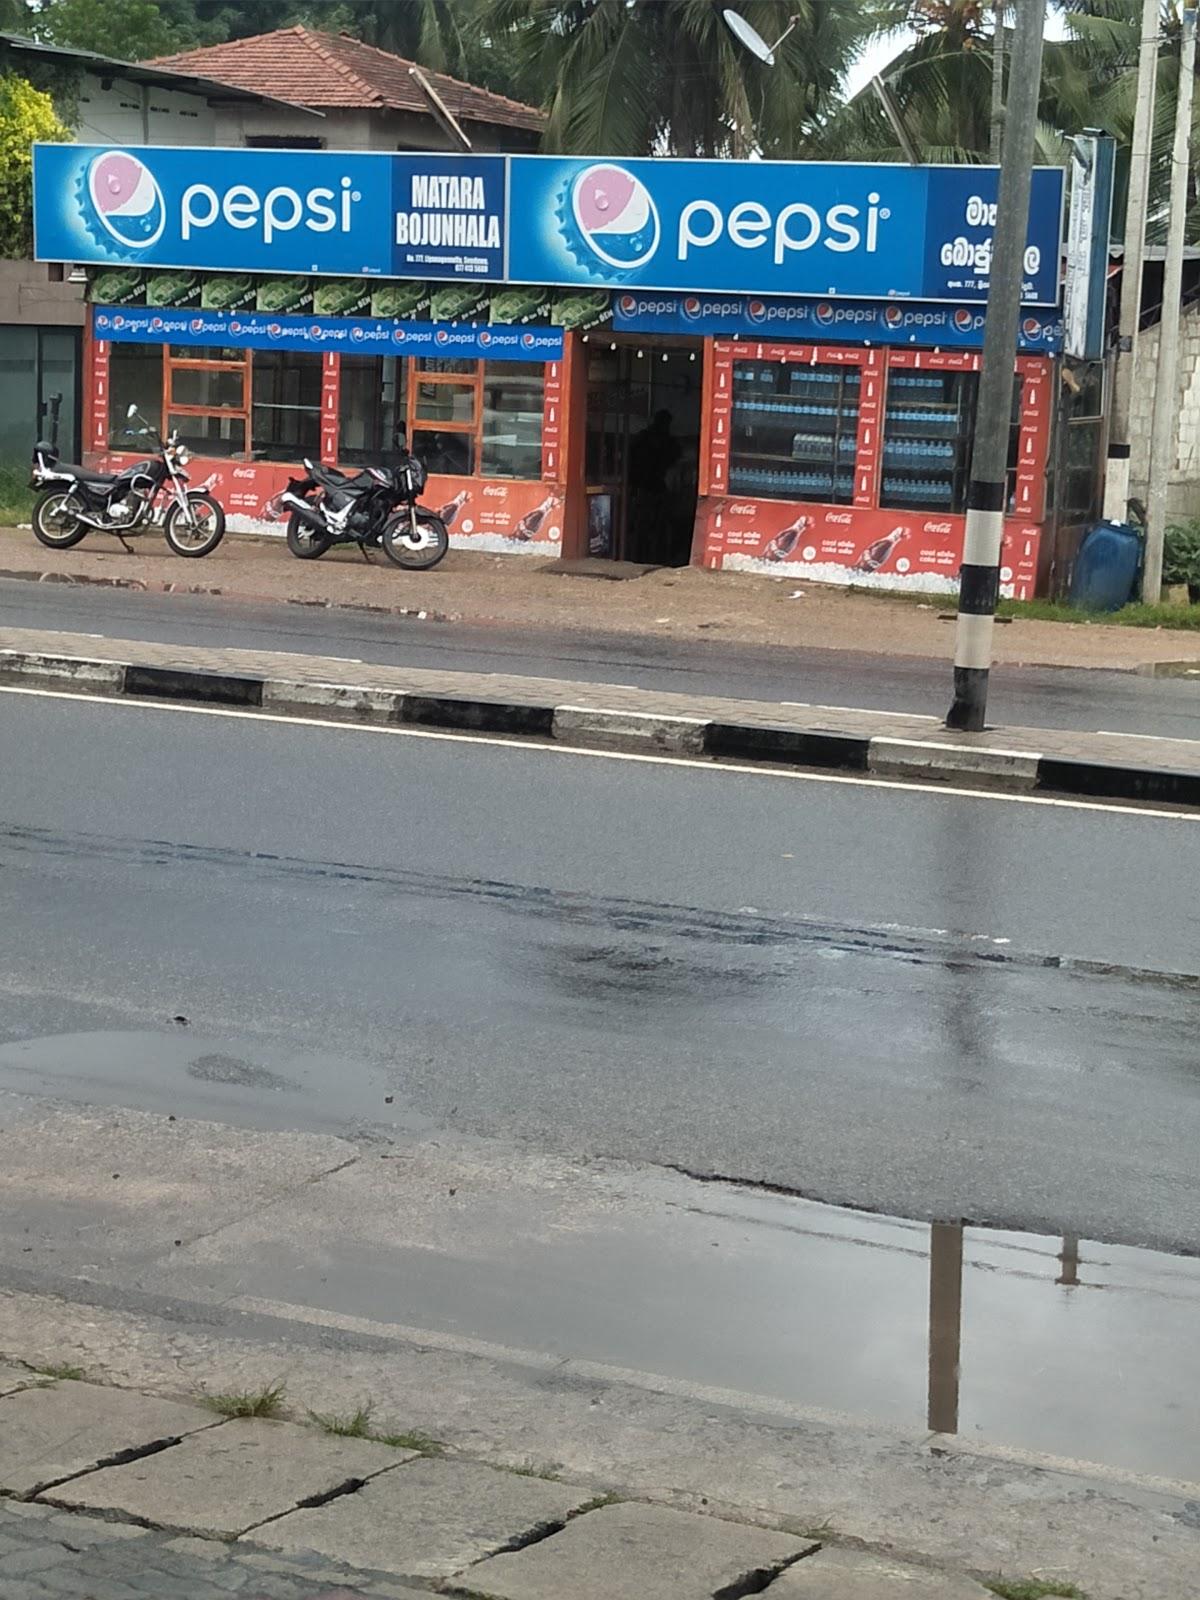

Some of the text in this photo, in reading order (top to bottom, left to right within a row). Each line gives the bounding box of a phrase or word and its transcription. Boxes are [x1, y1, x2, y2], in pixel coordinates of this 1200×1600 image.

[181, 176, 353, 244] pepsi
[411, 175, 486, 210] MATARA
[395, 212, 501, 248] BOJUNHALA
[678, 192, 881, 265] pepsi
[638, 299, 947, 328] pepsi pepsi pepsi pepsi pepsi
[406, 332, 432, 343] pepsi
[448, 333, 475, 344] pepsi
[491, 335, 518, 346] pepsi
[535, 336, 562, 348] pepsi
